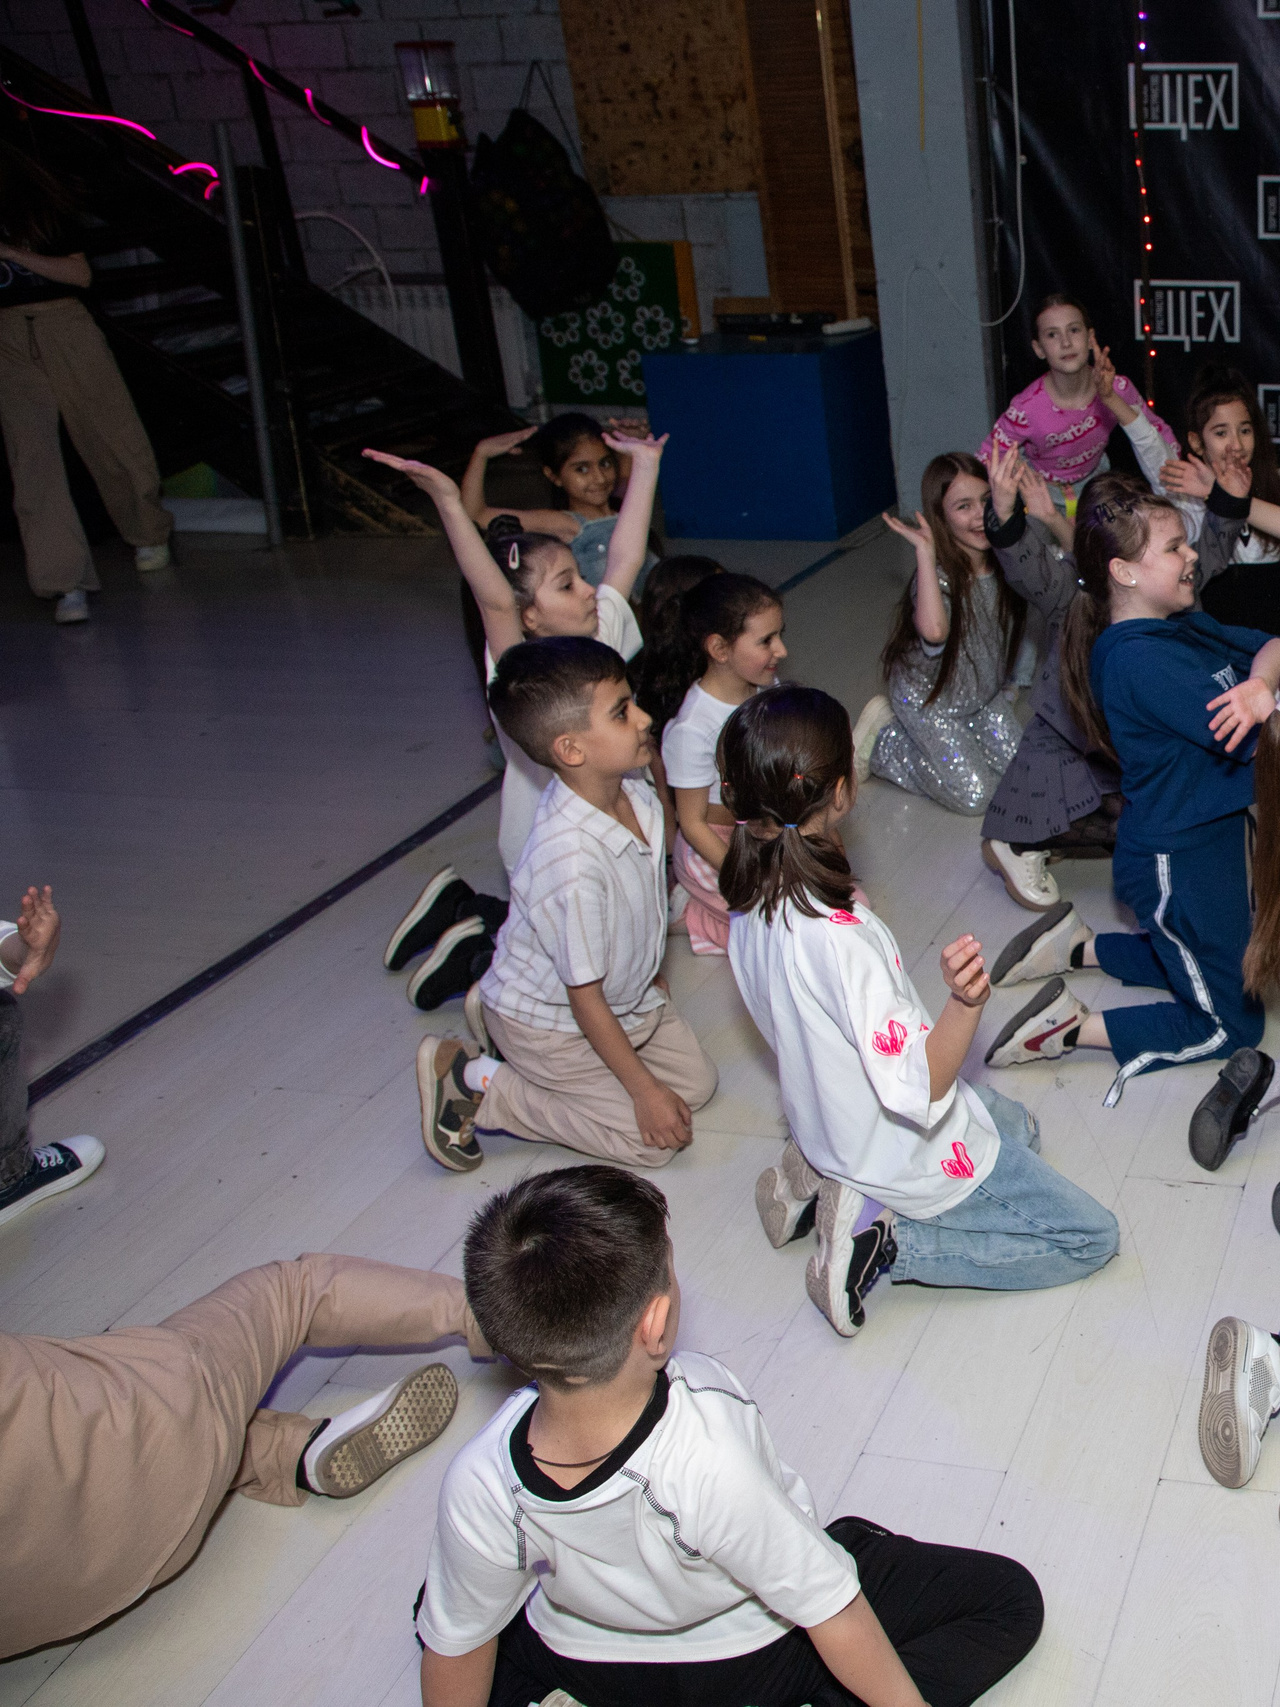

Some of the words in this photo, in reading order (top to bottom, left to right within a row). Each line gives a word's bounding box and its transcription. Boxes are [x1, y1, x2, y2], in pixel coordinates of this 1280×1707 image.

[1161, 72, 1230, 142] ЦЕХ
[1166, 289, 1232, 353] ЦЕХ
[1045, 415, 1097, 448] Barbie
